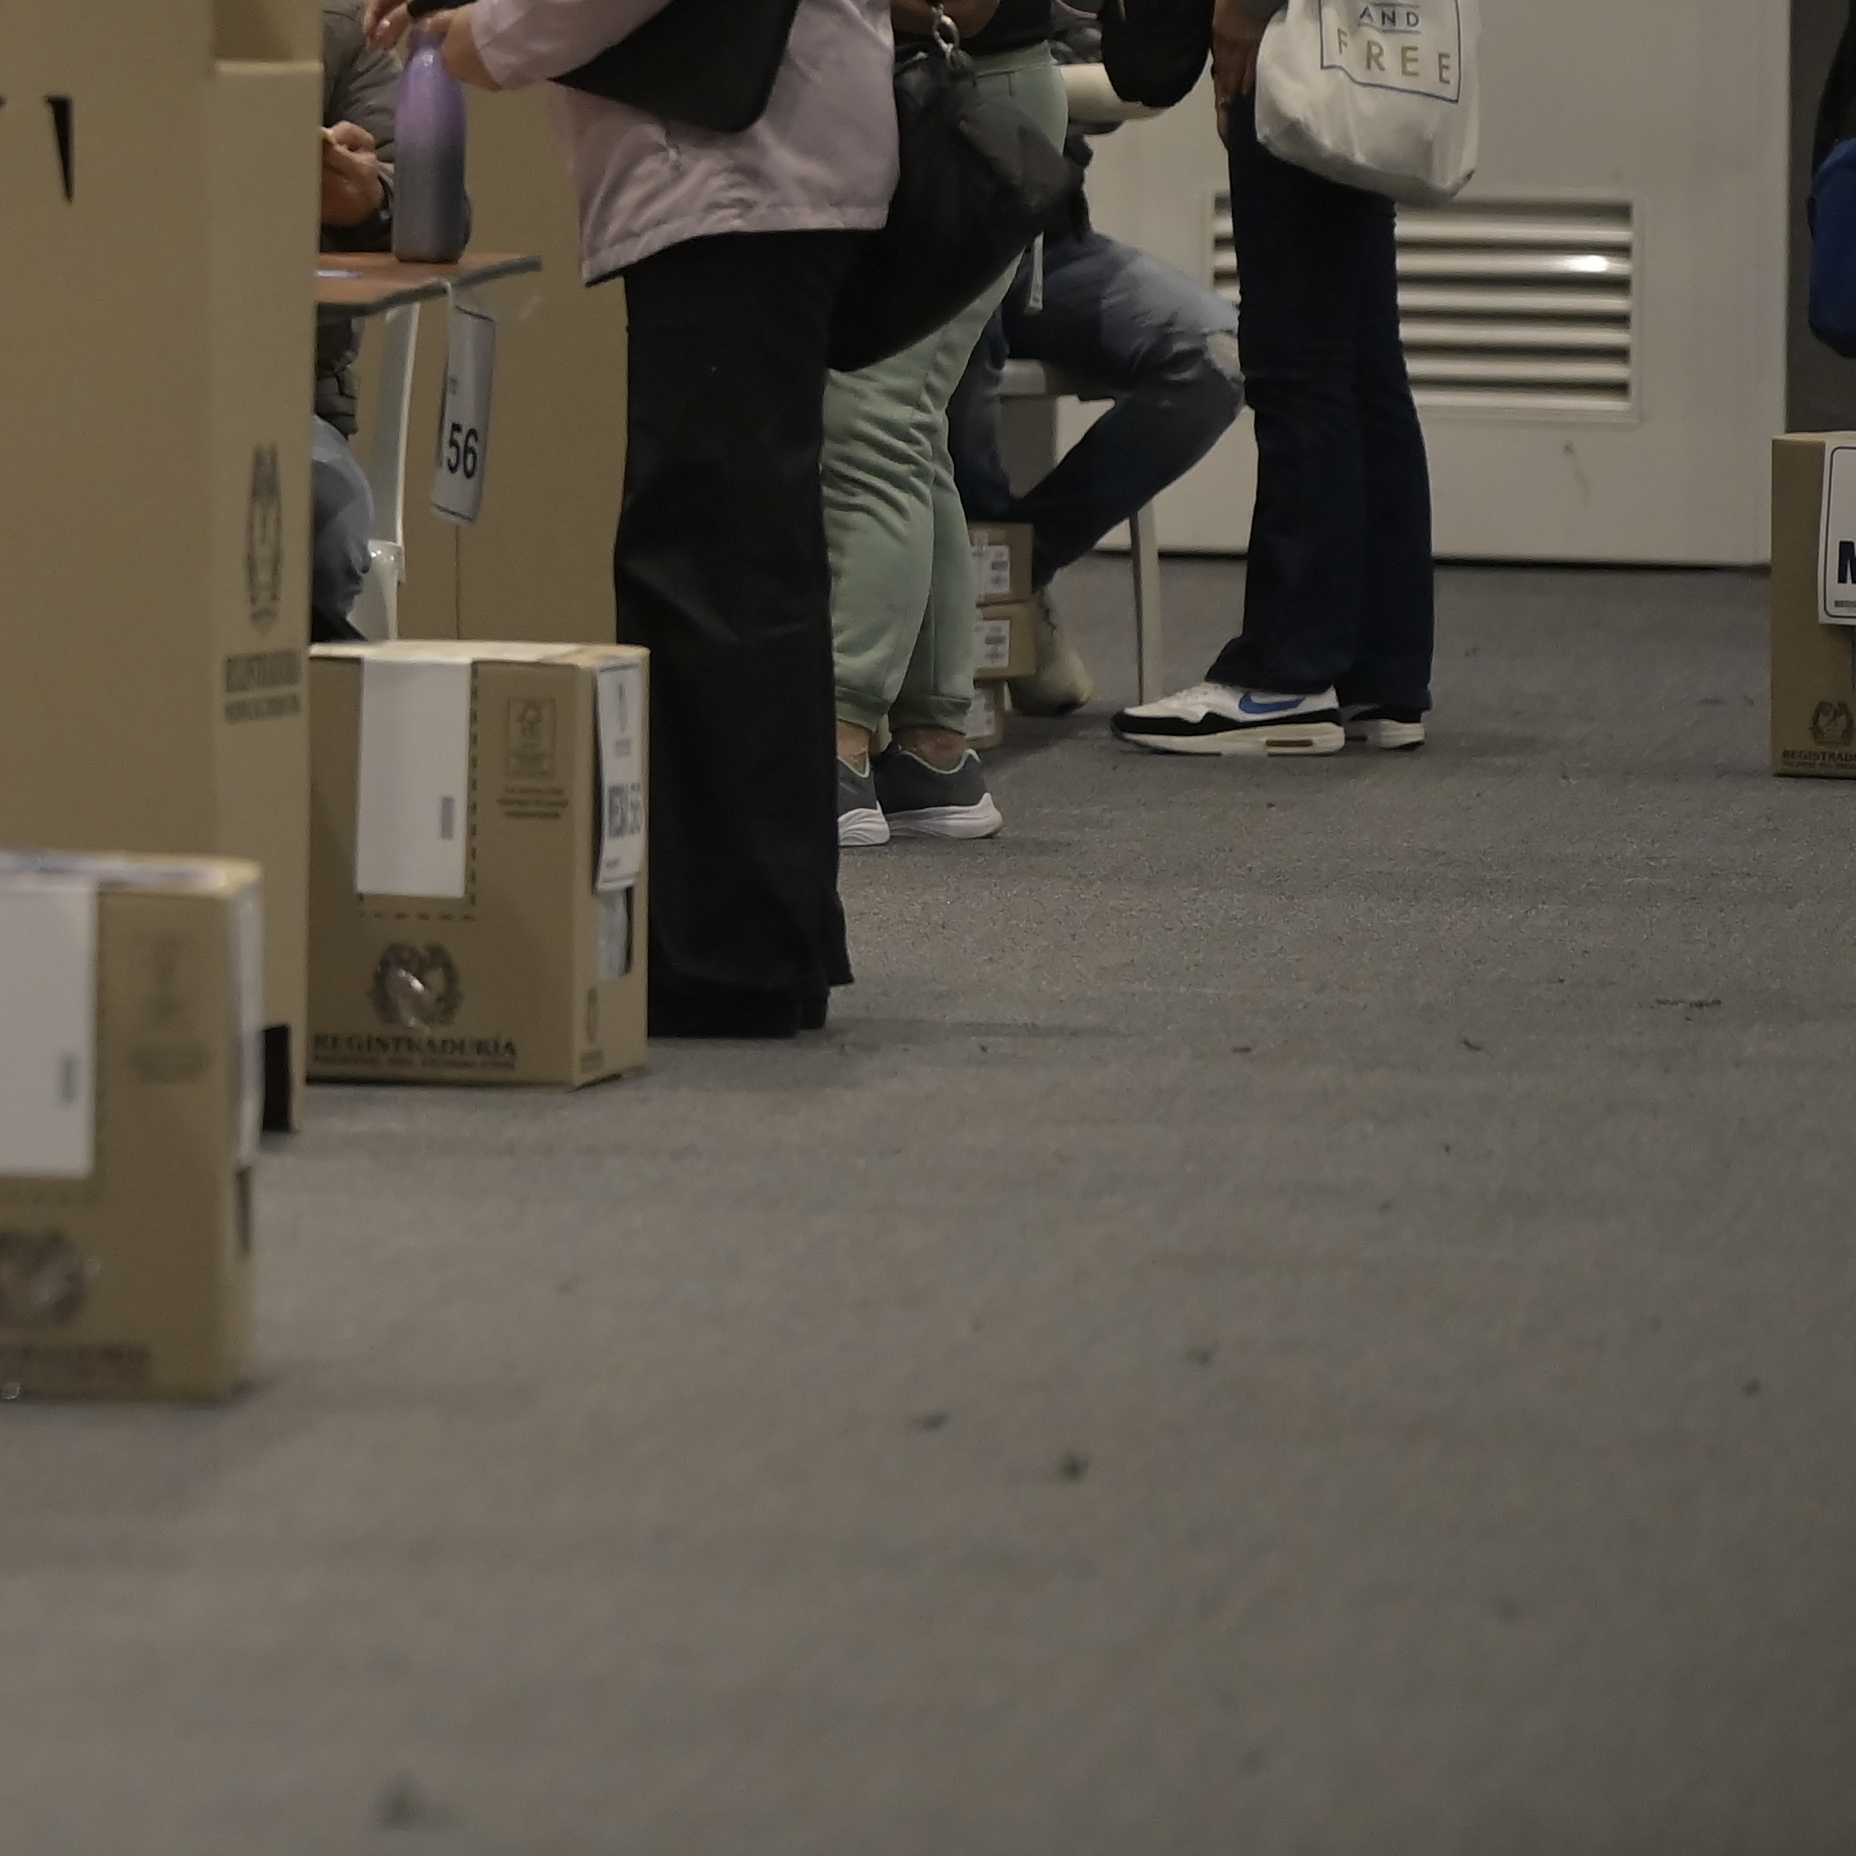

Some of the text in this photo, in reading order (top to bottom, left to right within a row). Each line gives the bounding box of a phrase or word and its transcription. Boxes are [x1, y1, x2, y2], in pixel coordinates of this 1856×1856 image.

[1359, 7, 1419, 27] AND
[1337, 28, 1450, 85] FREE
[448, 422, 478, 478] 56
